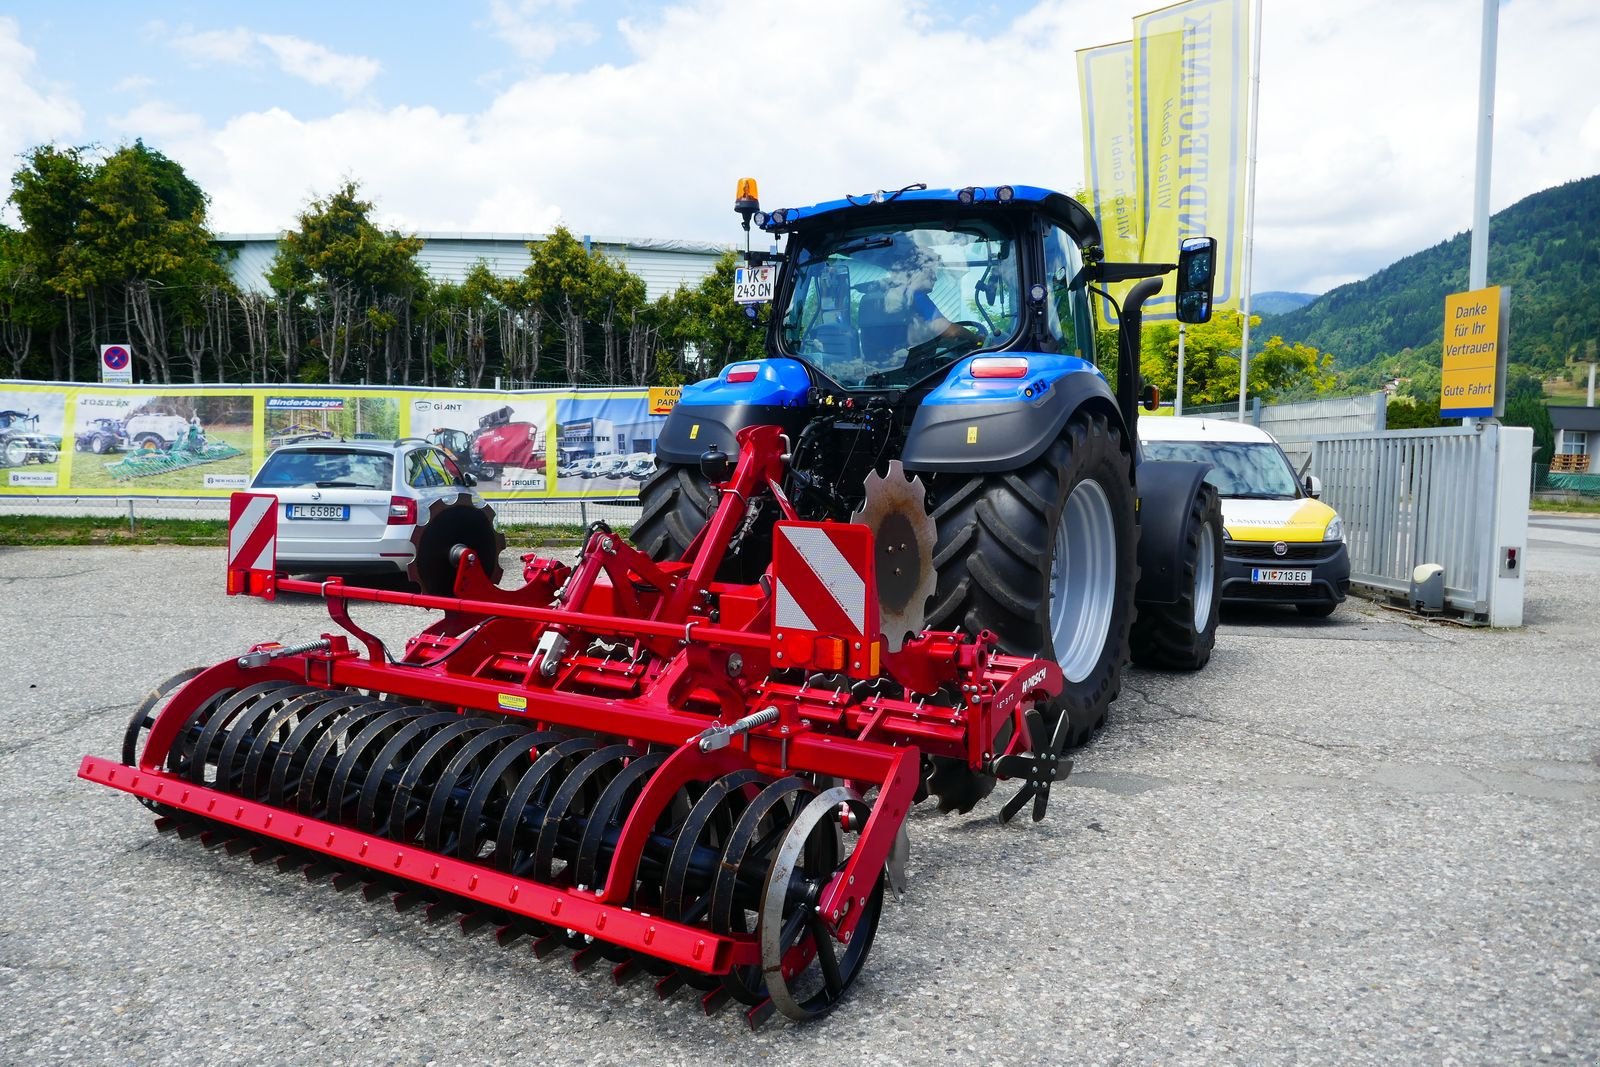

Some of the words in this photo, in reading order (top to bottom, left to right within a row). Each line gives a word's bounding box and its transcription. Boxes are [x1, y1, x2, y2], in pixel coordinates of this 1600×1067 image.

[747, 269, 760, 283] VK
[737, 284, 756, 298] 243
[758, 283, 772, 297] CN
[1455, 302, 1488, 319] Danke
[1454, 324, 1469, 338] für
[1472, 321, 1486, 336] Ihr
[1446, 342, 1495, 357] Vertrauen
[1443, 384, 1465, 397] Gute
[1467, 382, 1492, 395] Fahrt
[269, 399, 342, 408] Binderberger
[294, 506, 306, 517] FL
[310, 506, 342, 517] 658BC
[1262, 571, 1271, 580] VI
